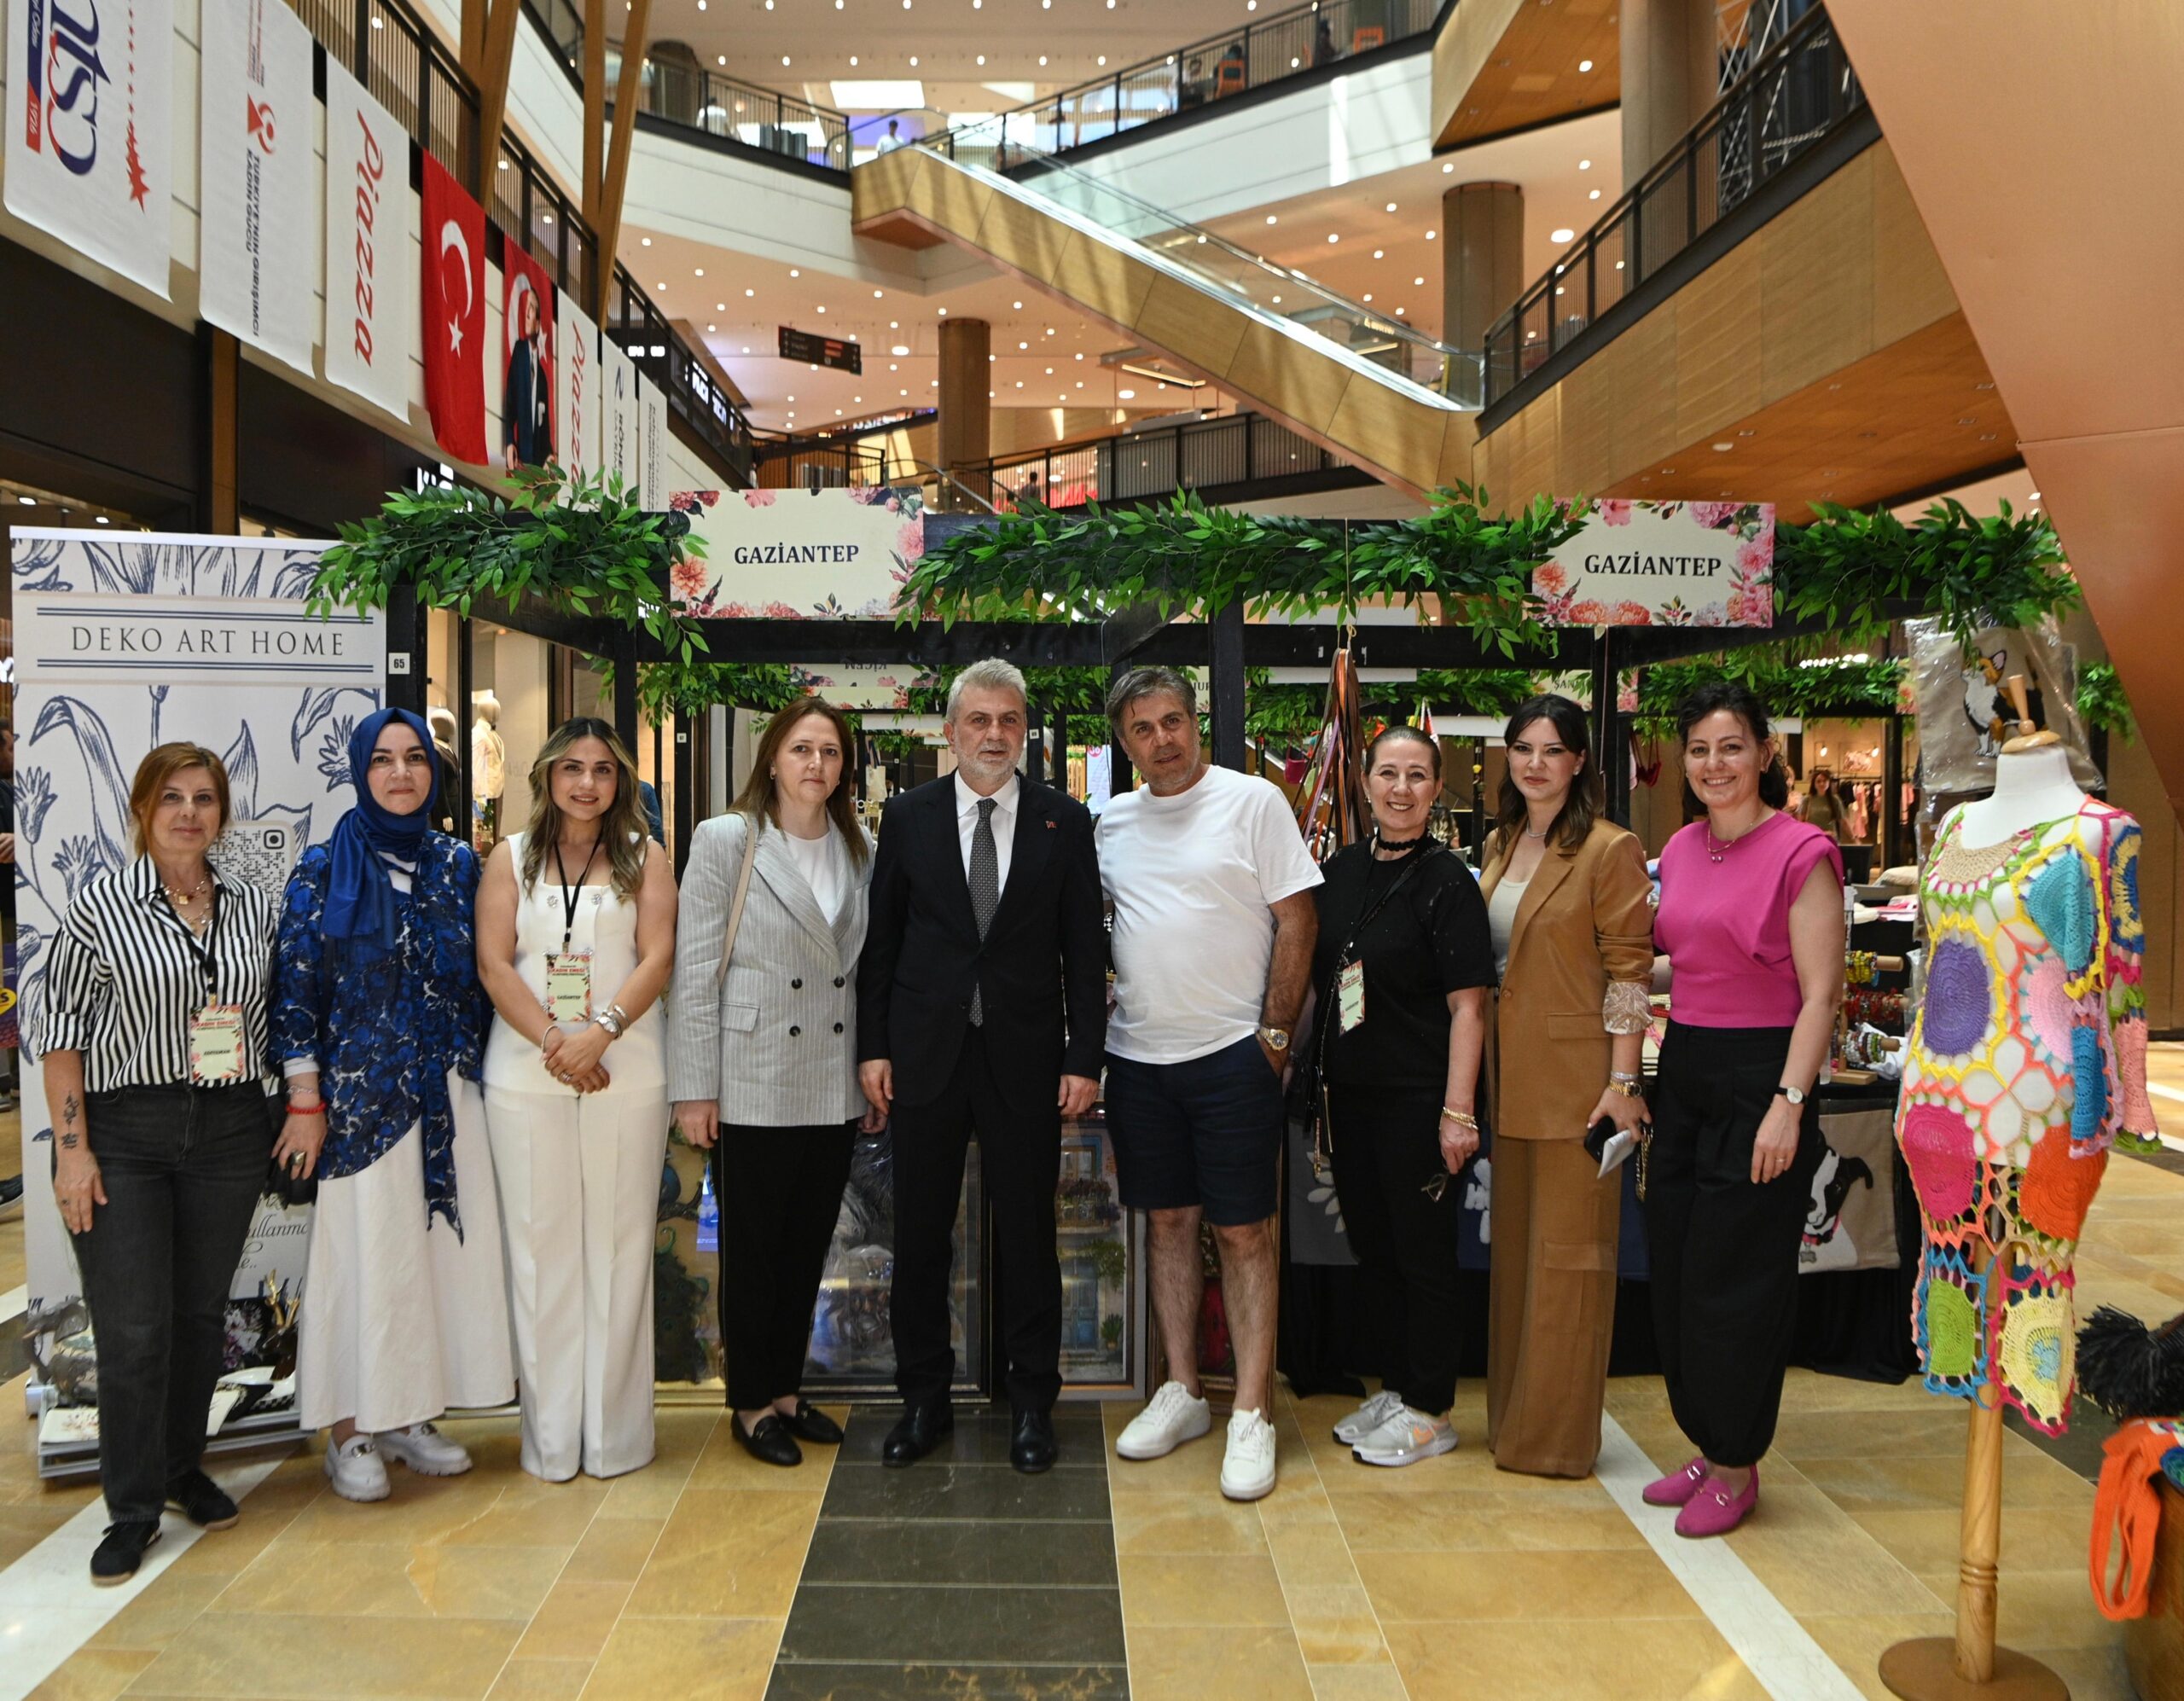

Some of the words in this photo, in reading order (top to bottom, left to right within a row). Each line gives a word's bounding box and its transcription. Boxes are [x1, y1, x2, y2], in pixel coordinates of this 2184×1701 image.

[354, 109, 384, 369] Piazza
[734, 542, 860, 565] GAZİANTEP
[1584, 550, 1722, 577] GAZİANTEP
[72, 626, 162, 652] DEKO
[177, 630, 236, 653] ART
[252, 630, 344, 655] HOME
[393, 659, 405, 669] 65
